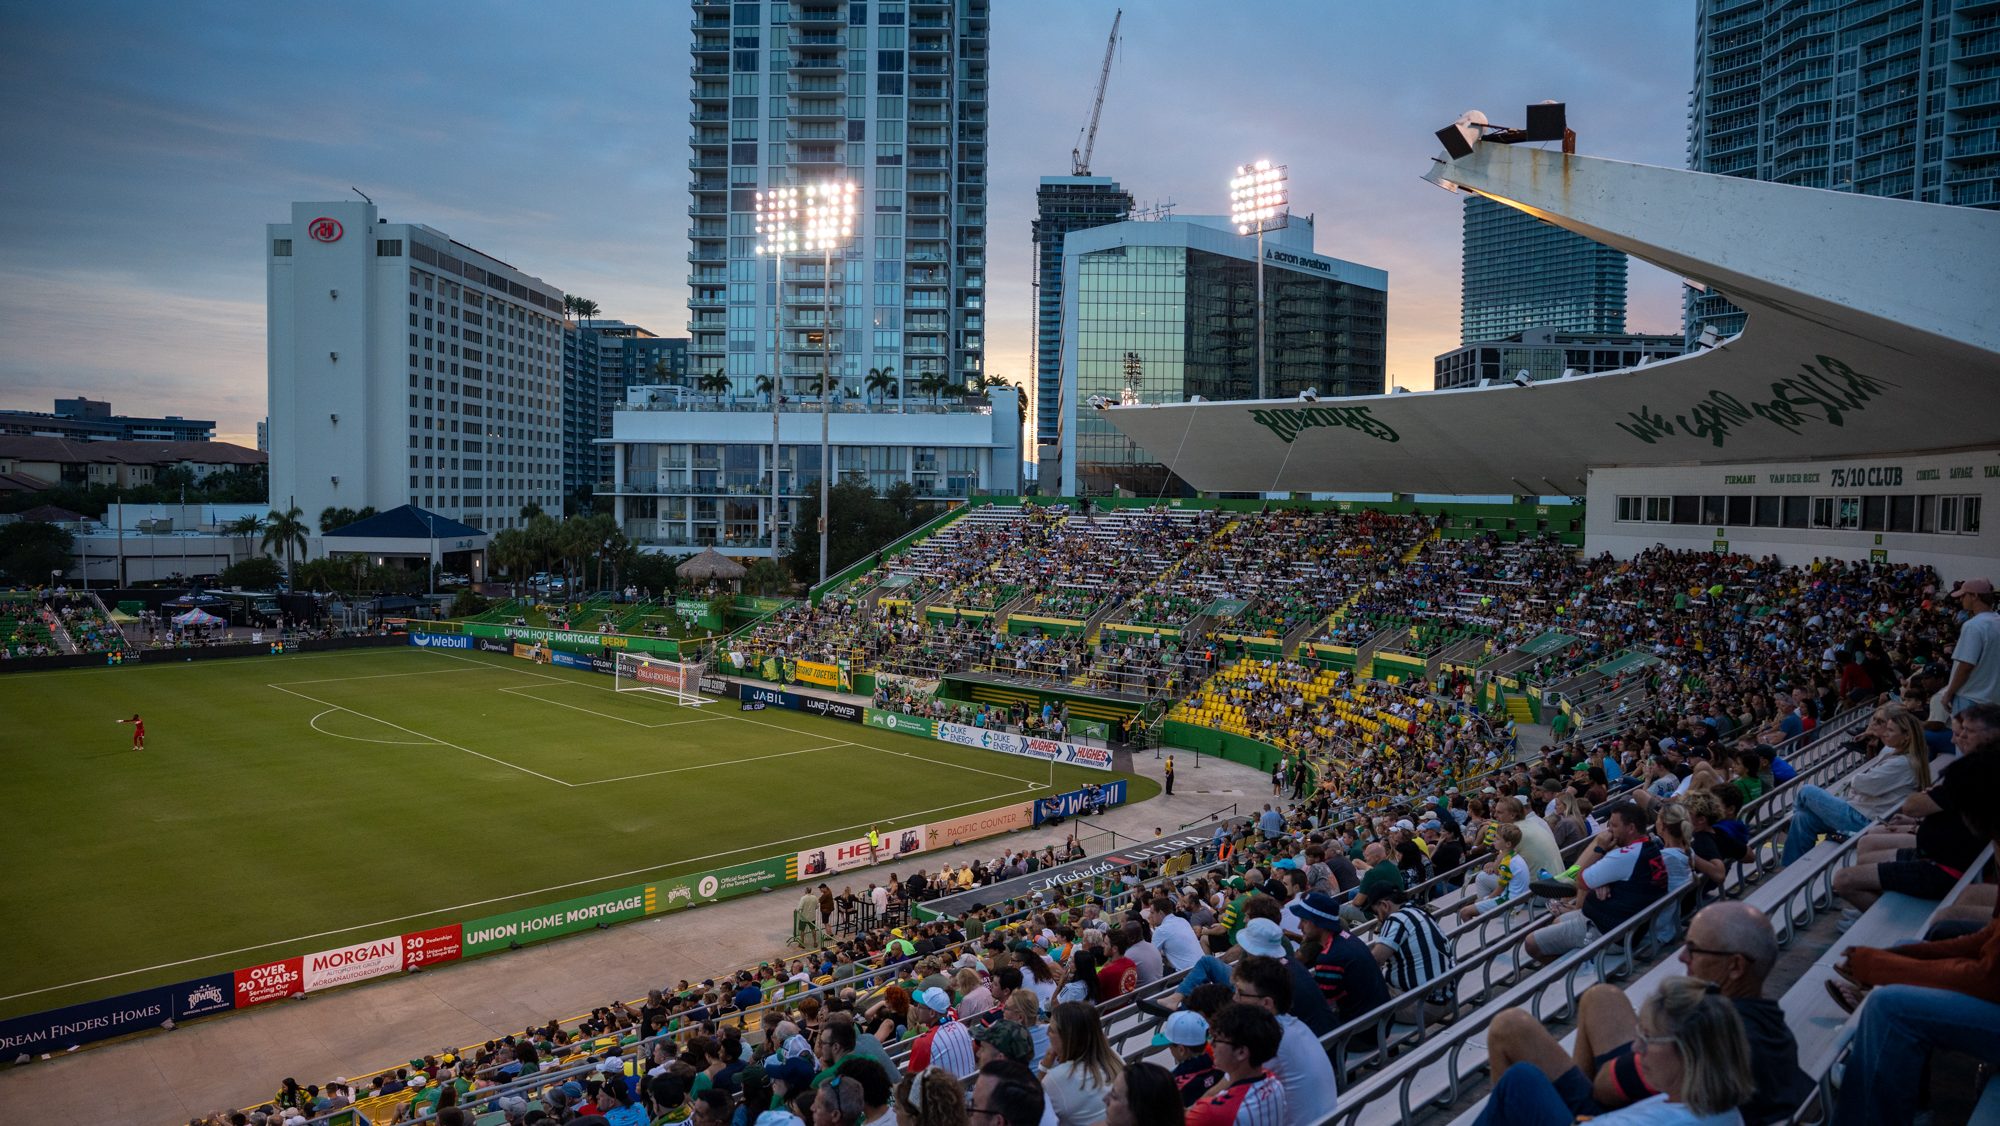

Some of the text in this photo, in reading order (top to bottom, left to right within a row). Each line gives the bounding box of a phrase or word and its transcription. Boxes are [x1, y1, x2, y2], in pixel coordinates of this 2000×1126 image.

[1274, 251, 1331, 272] acron aviation
[1248, 406, 1400, 443] ROWDIES
[1724, 475, 1756, 485] FIRMANI
[1770, 474, 1785, 484] VAN
[1786, 474, 1801, 484] DER
[1803, 473, 1820, 483] BECK
[1831, 467, 1865, 488] 75/10
[1868, 466, 1903, 487] CLUB
[1950, 466, 1974, 479] SAVAGE
[432, 635, 467, 649] Webull
[504, 628, 628, 647] UNION HOME MORTGAGE BERM
[592, 660, 613, 668] COLONY
[618, 664, 636, 673] GRILL
[753, 690, 785, 705] JABIL
[951, 725, 967, 735] DUKE
[994, 733, 1010, 743] DUKE
[950, 734, 974, 745] ENERGY
[993, 742, 1018, 753] ENERGY
[1029, 739, 1058, 753] HUGHES
[1074, 757, 1105, 767] EXTERMINATORS
[1076, 747, 1107, 761] HUGHES
[1068, 784, 1118, 815] Well
[947, 814, 1017, 838] PACIFIC COUNTER
[838, 838, 891, 860] HEI
[1028, 836, 1208, 892] Michelob ULTRA
[721, 870, 765, 884] Official Supermarket
[467, 896, 642, 944] UNION HOME MORTGAGE
[407, 934, 452, 950] 30 Dealerships
[313, 941, 394, 972] MORGAN
[407, 950, 424, 963] 23
[250, 964, 286, 980] OVER
[312, 964, 395, 987] MORGANAUTOGROUP.COM
[326, 959, 382, 977] AUTOMOTIVE GROUP
[238, 971, 298, 993] 20 YEARS
[188, 988, 222, 1009] ROWDIES
[249, 986, 275, 997] Serving
[250, 990, 288, 1003] Community
[51, 1015, 109, 1039] FINDERS
[112, 1004, 161, 1025] HOMES
